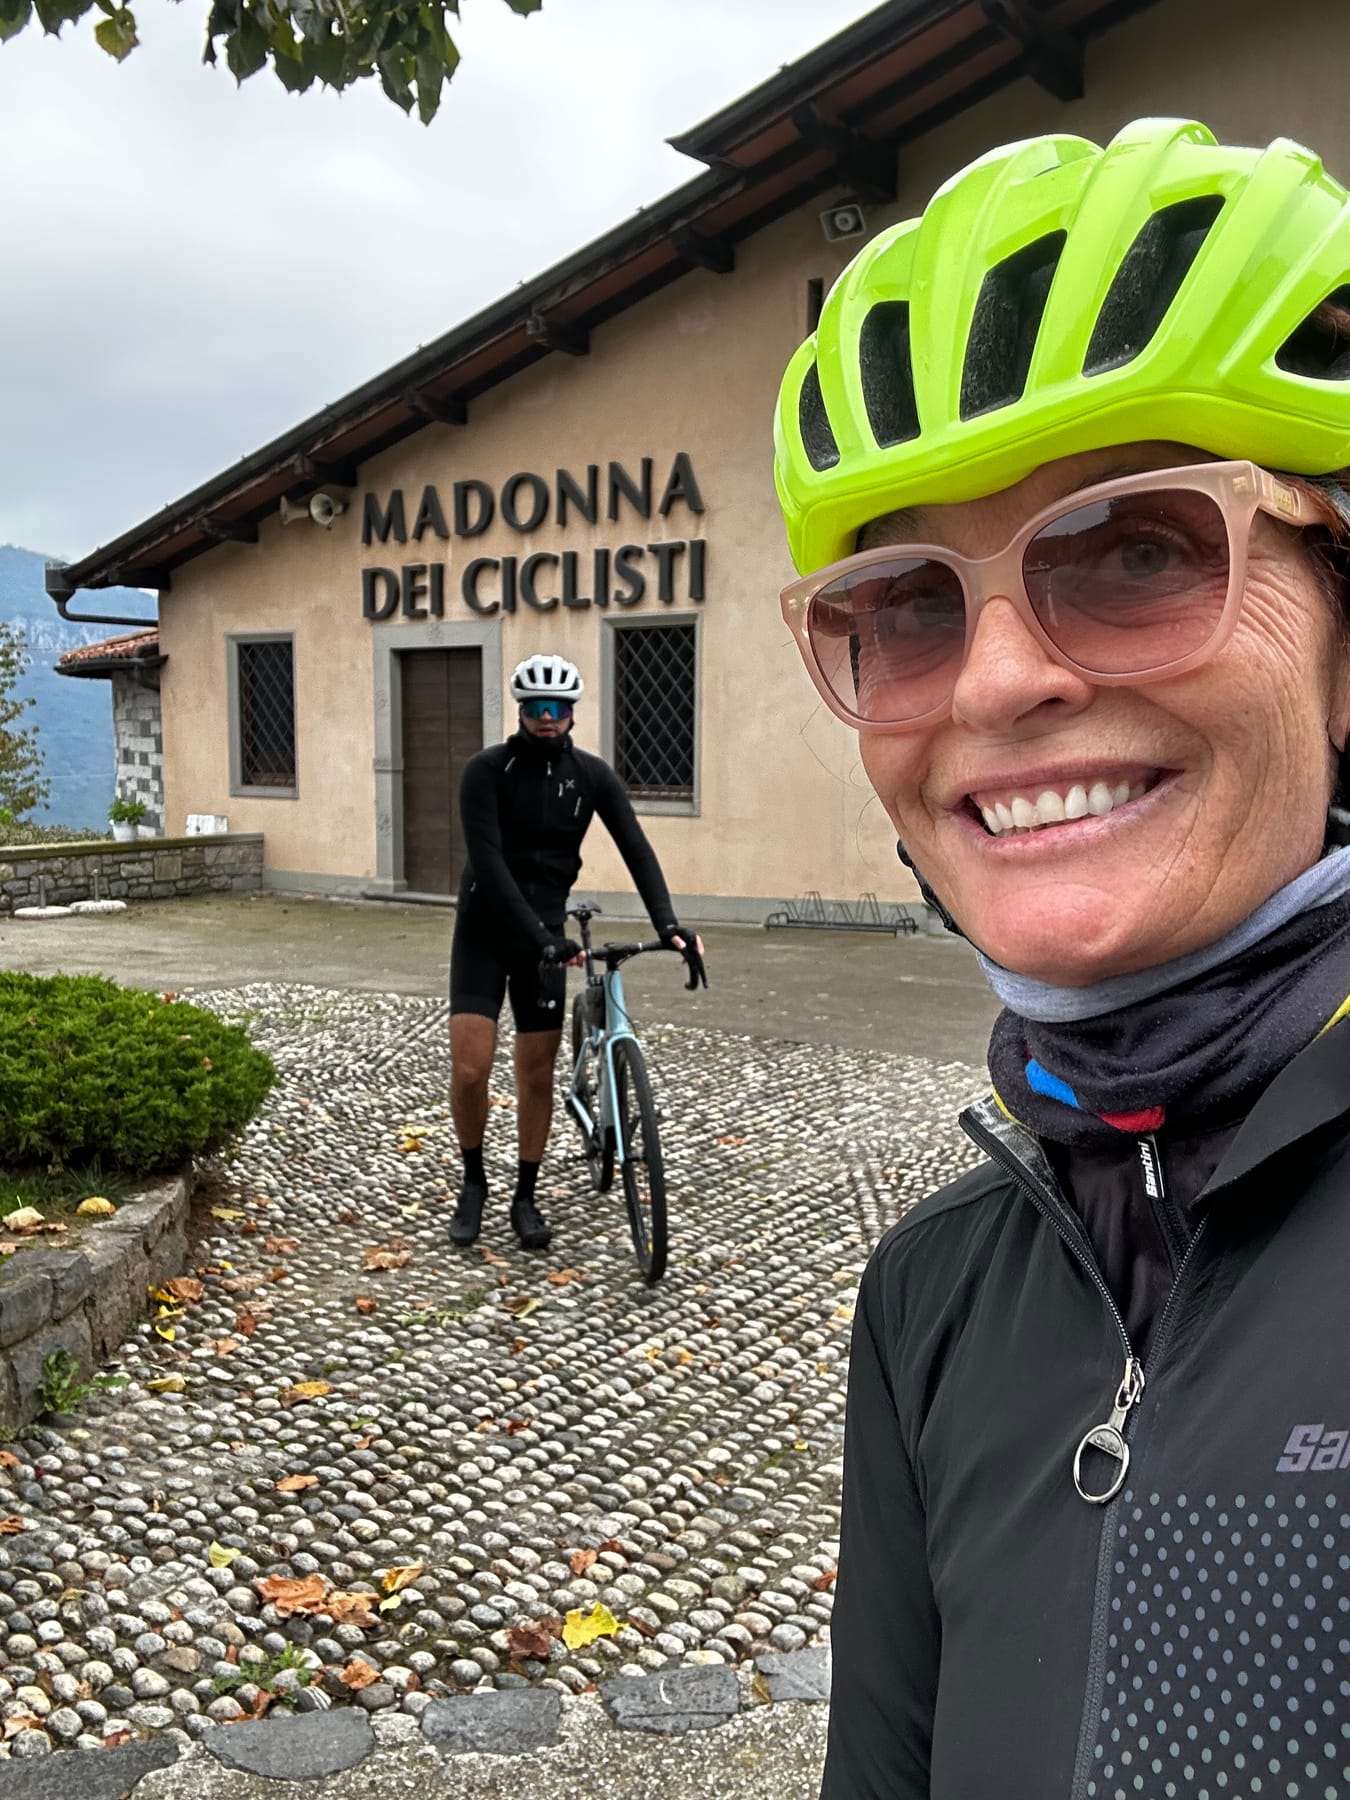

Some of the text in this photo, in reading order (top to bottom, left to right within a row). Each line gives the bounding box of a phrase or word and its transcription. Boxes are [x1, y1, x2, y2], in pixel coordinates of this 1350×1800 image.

[361, 452, 705, 545] MADONNA
[362, 538, 706, 620] DEI CICLISTI
[1138, 1141, 1158, 1198] Santini
